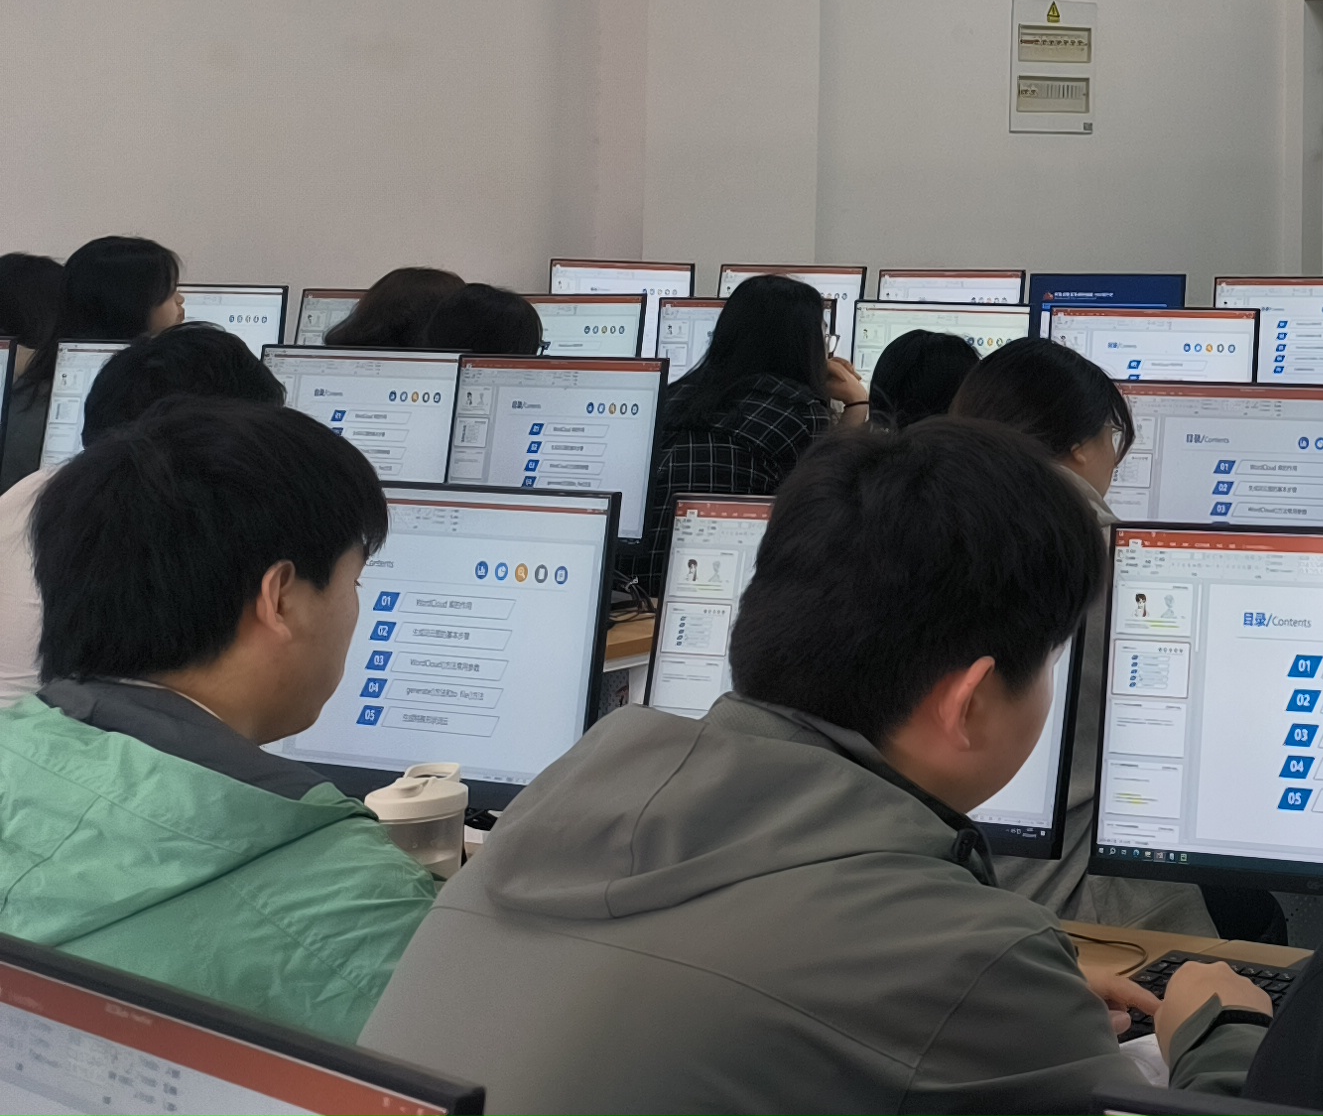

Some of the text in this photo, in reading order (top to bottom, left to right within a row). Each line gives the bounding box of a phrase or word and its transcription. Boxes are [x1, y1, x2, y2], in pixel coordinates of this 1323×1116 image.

[1219, 462, 1229, 471] 01
[381, 595, 392, 606] 01
[1243, 611, 1312, 629] 目录/Contents
[377, 625, 389, 636] 02
[373, 654, 384, 666] 03
[1298, 659, 1311, 673] 01
[1296, 693, 1311, 707] 02
[1293, 728, 1309, 742] 03
[1289, 759, 1305, 773] 04
[1287, 791, 1302, 805] 05
